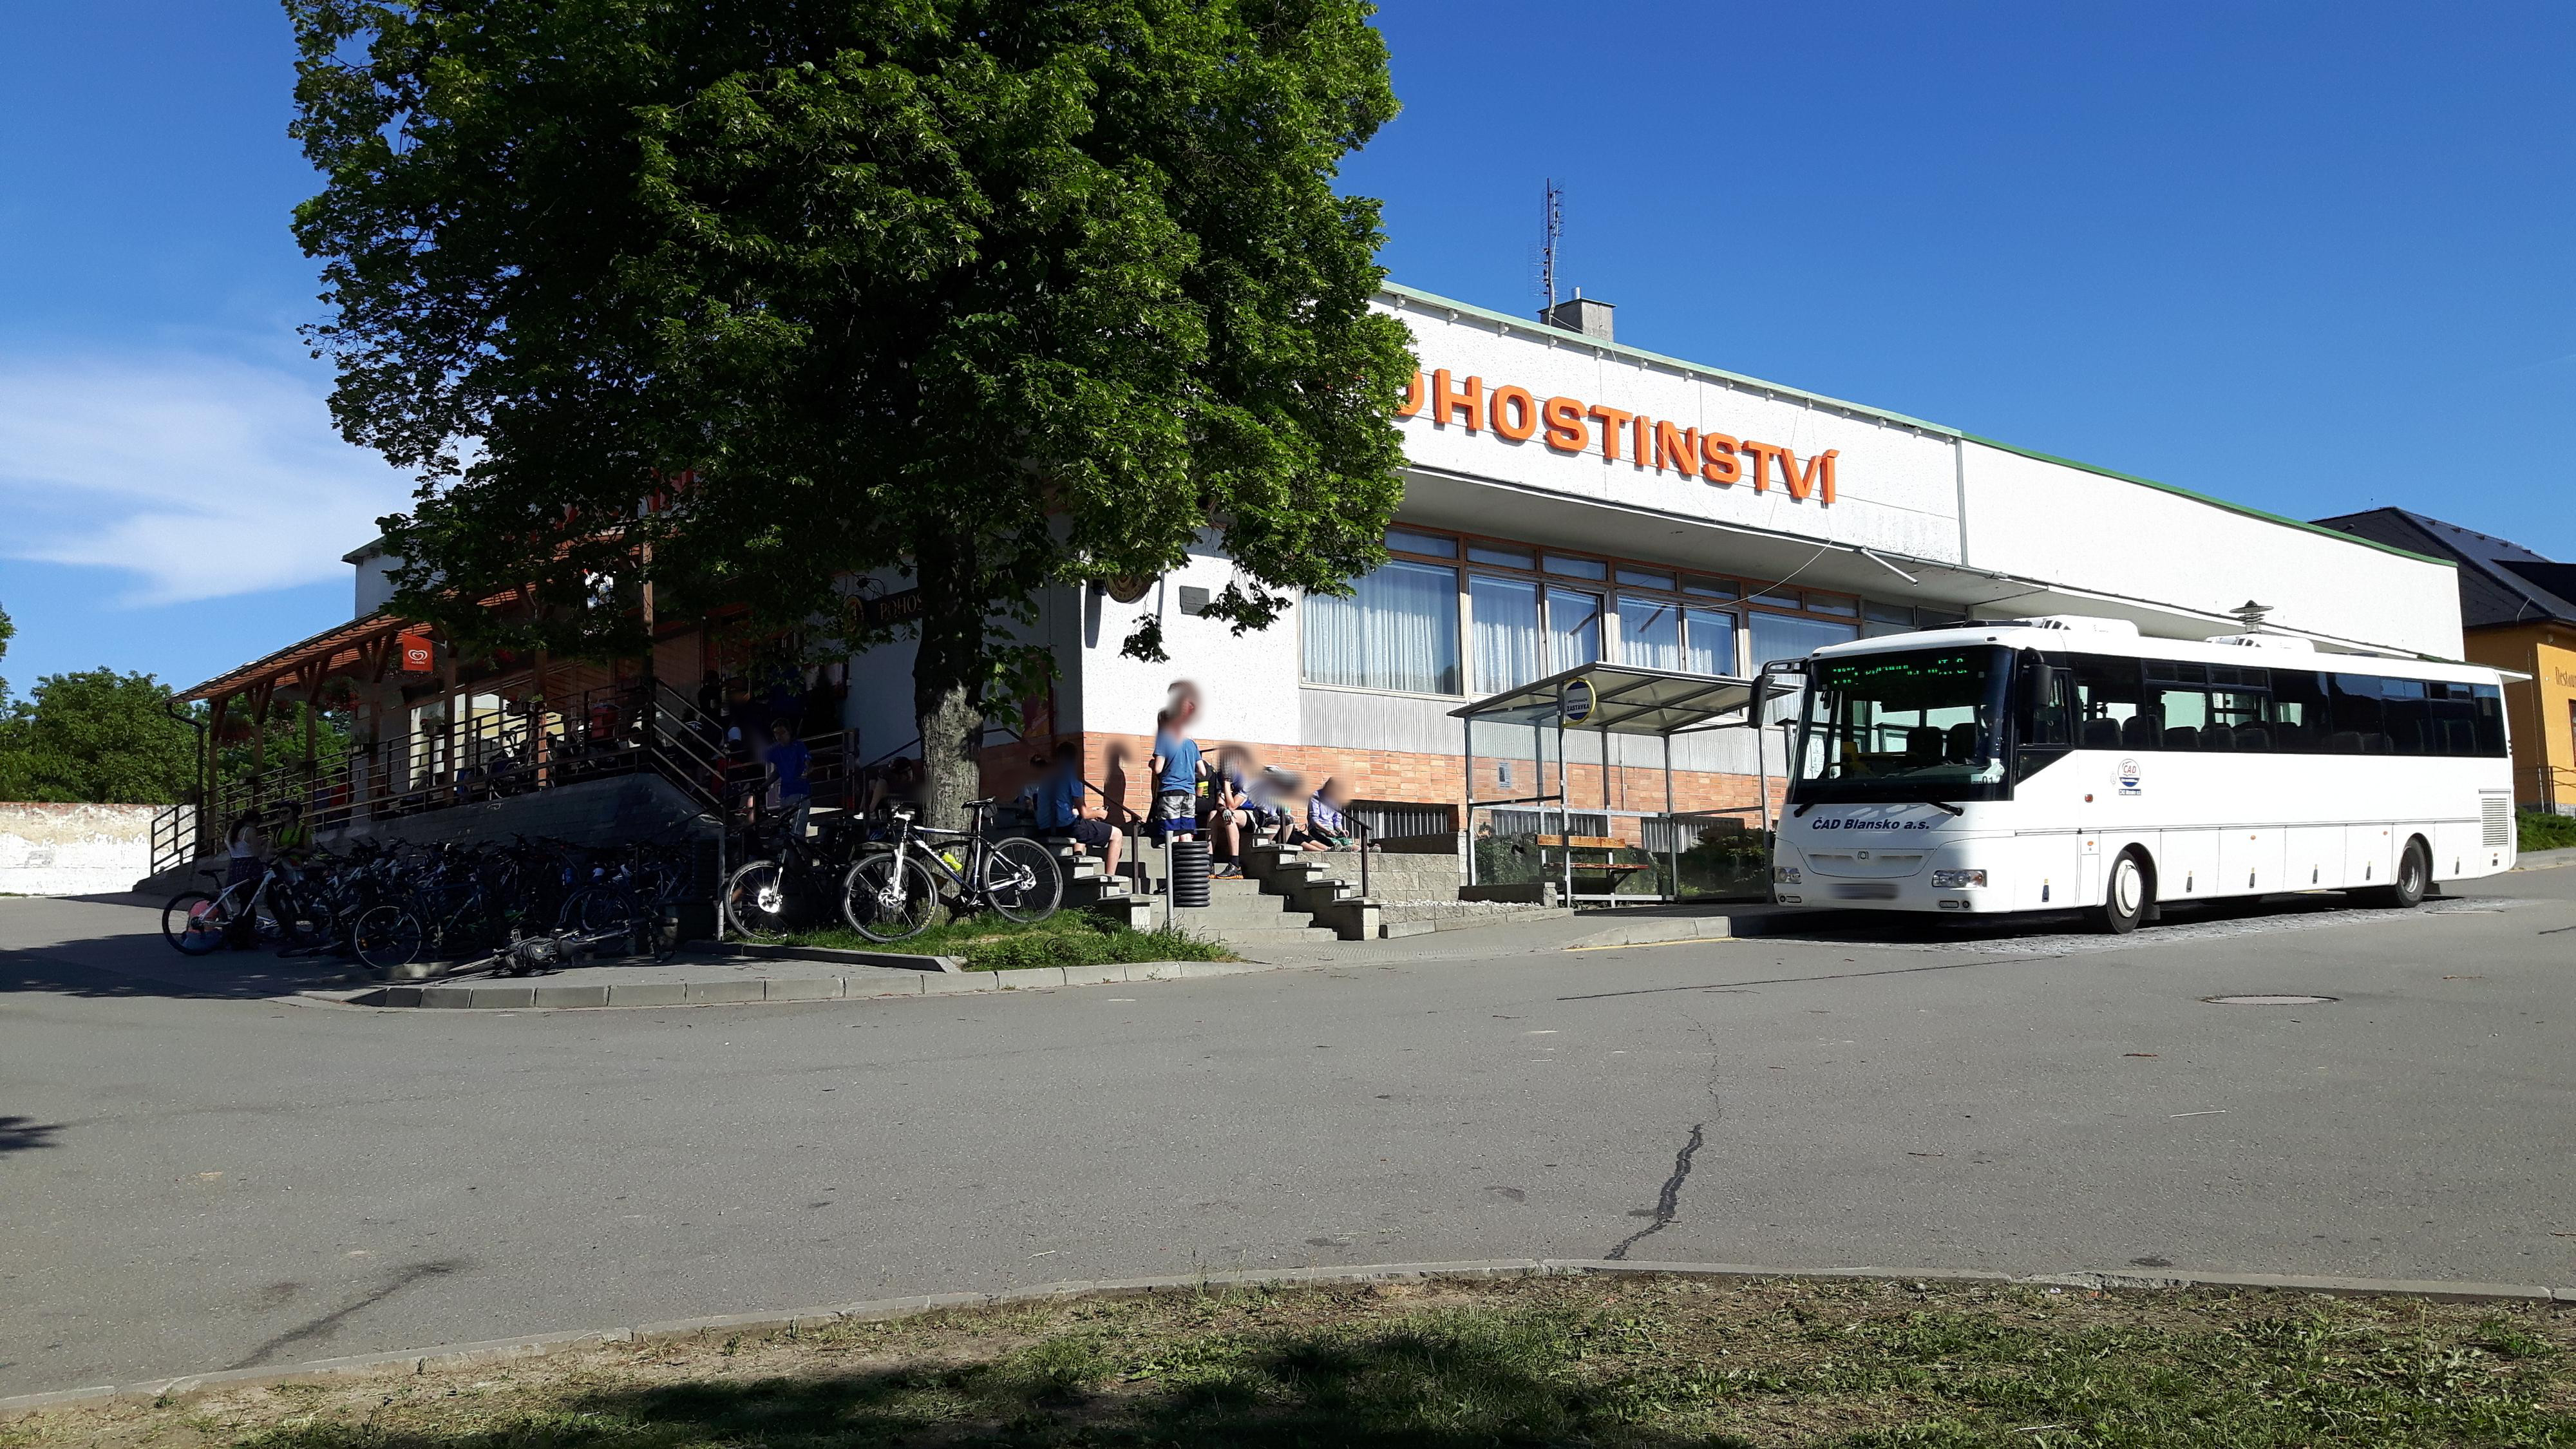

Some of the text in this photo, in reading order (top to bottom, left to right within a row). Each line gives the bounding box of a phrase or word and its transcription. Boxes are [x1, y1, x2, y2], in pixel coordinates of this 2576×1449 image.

[1812, 817, 1929, 829] ČAD Blansko a.s.
